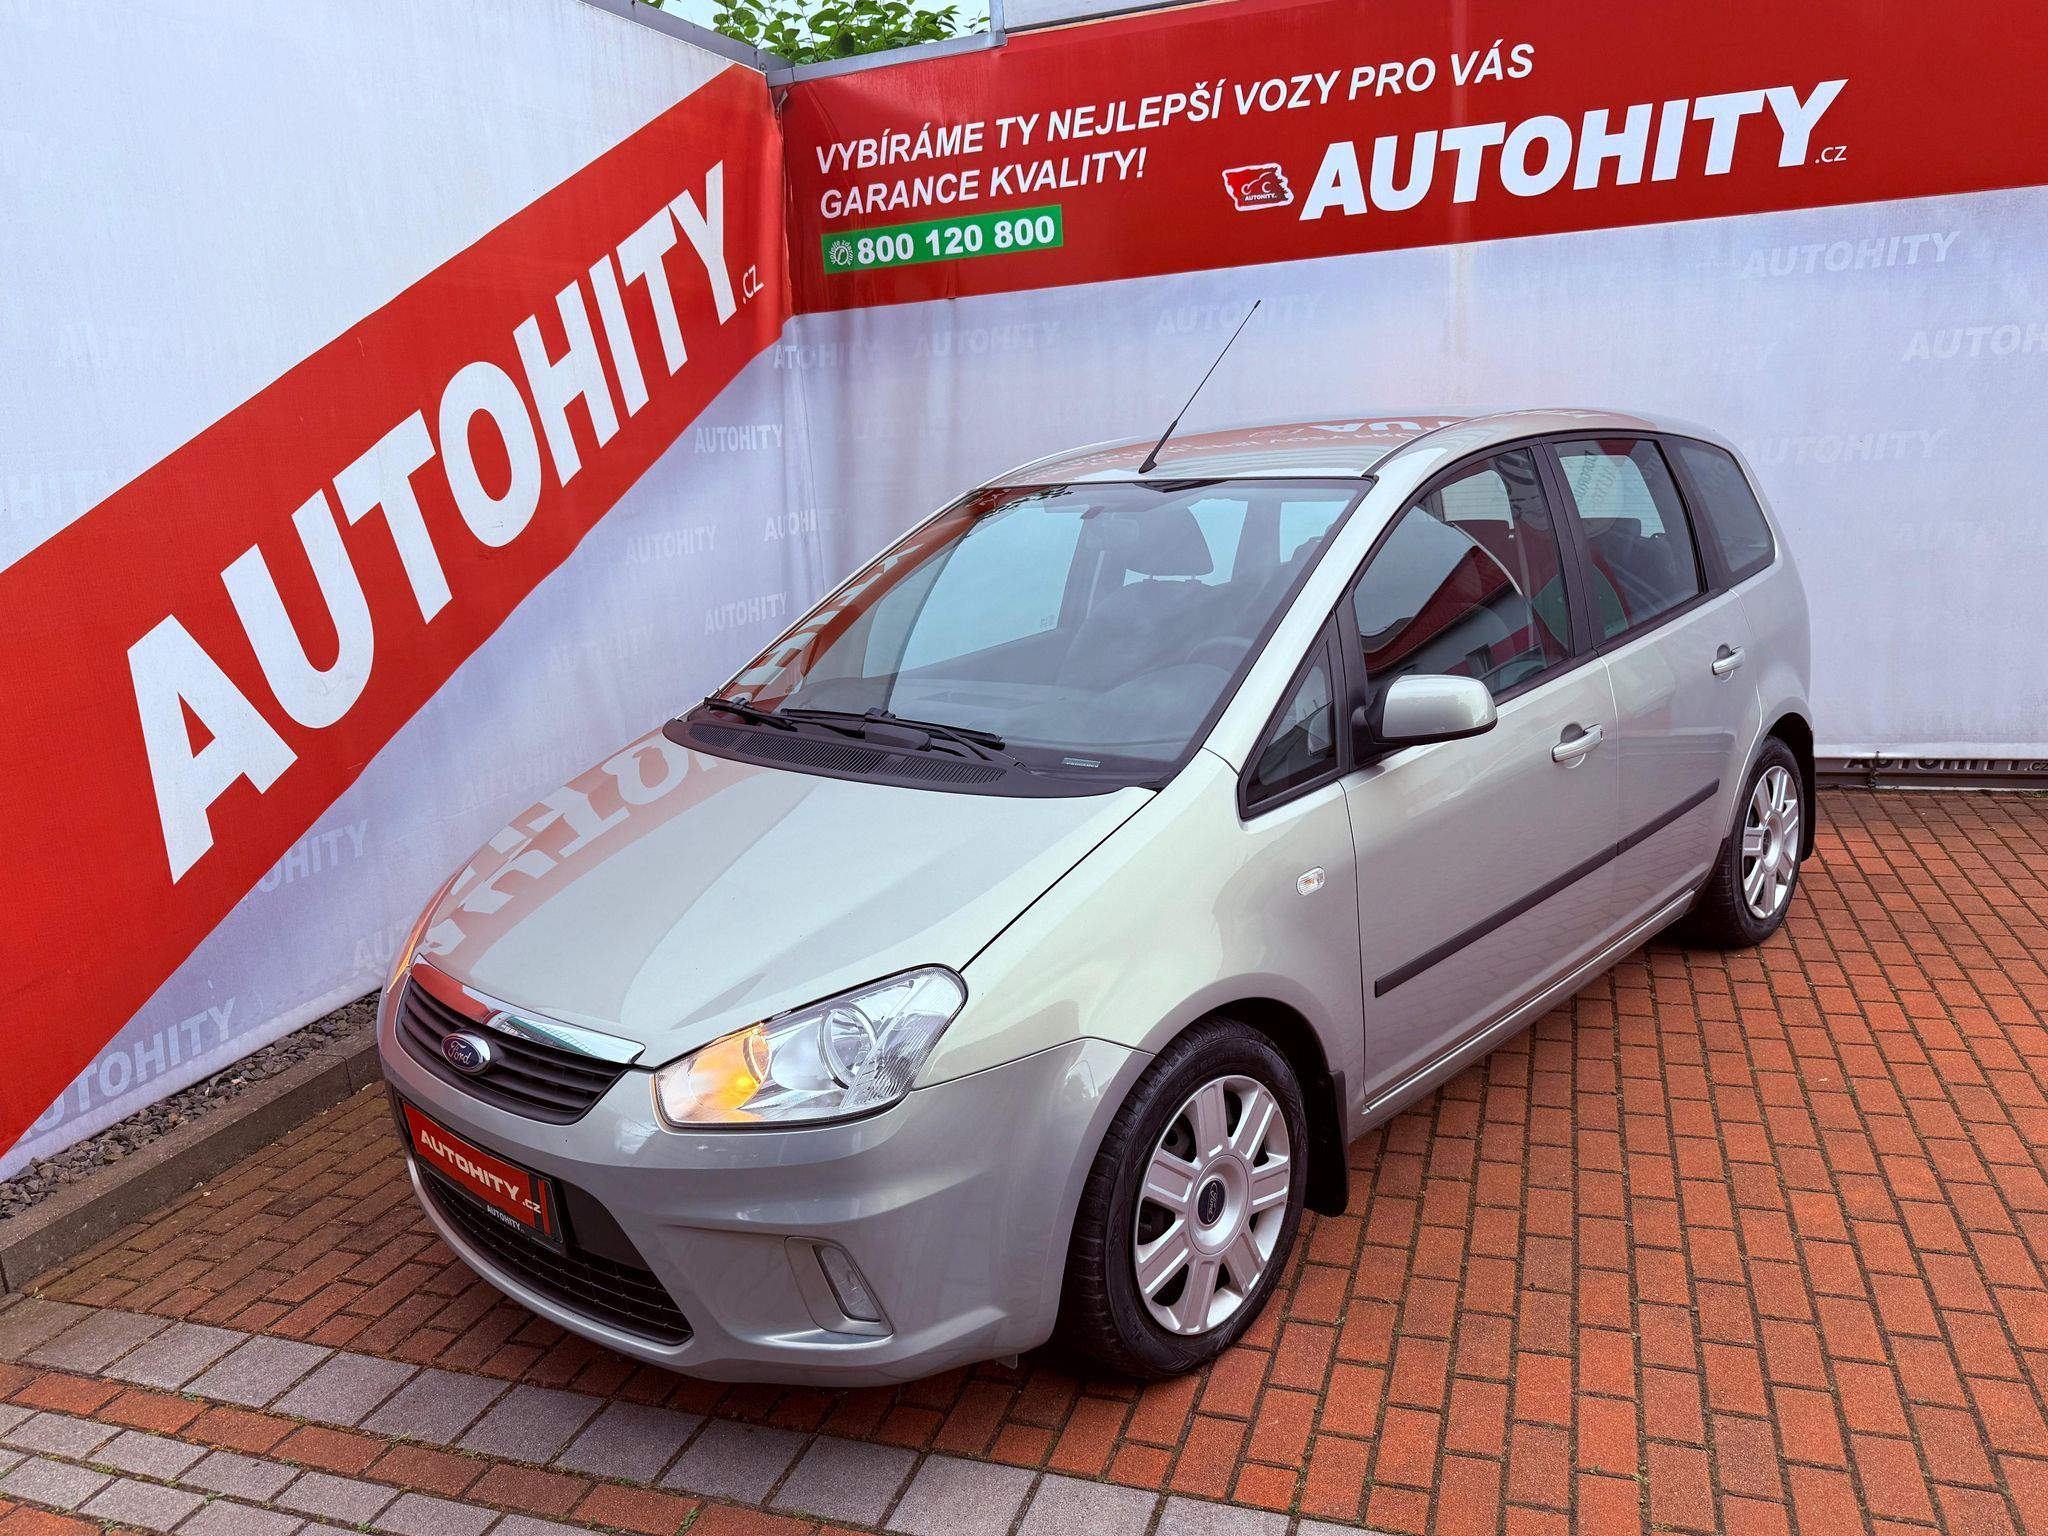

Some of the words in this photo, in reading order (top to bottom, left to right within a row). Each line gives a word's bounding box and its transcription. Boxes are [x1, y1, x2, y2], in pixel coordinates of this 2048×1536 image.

[816, 121, 985, 174] VYBÍRÁME
[995, 113, 1040, 149] TY
[1047, 79, 1227, 142] NEJLEPŠÍ
[1235, 69, 1342, 116] VOZY
[1348, 57, 1436, 101] PRO
[1450, 38, 1535, 87] VÁS
[820, 169, 981, 219] GARANCE
[989, 146, 1147, 198] KVALITY!
[857, 233, 914, 264] 800
[926, 224, 983, 256] 120
[994, 216, 1055, 248] 800
[1740, 230, 1962, 279] AUTOHITY
[694, 424, 783, 453] AUTOHITY
[624, 524, 718, 566] AUTOHITY
[703, 592, 787, 636] AUTOHITY
[449, 1040, 471, 1065] Ford
